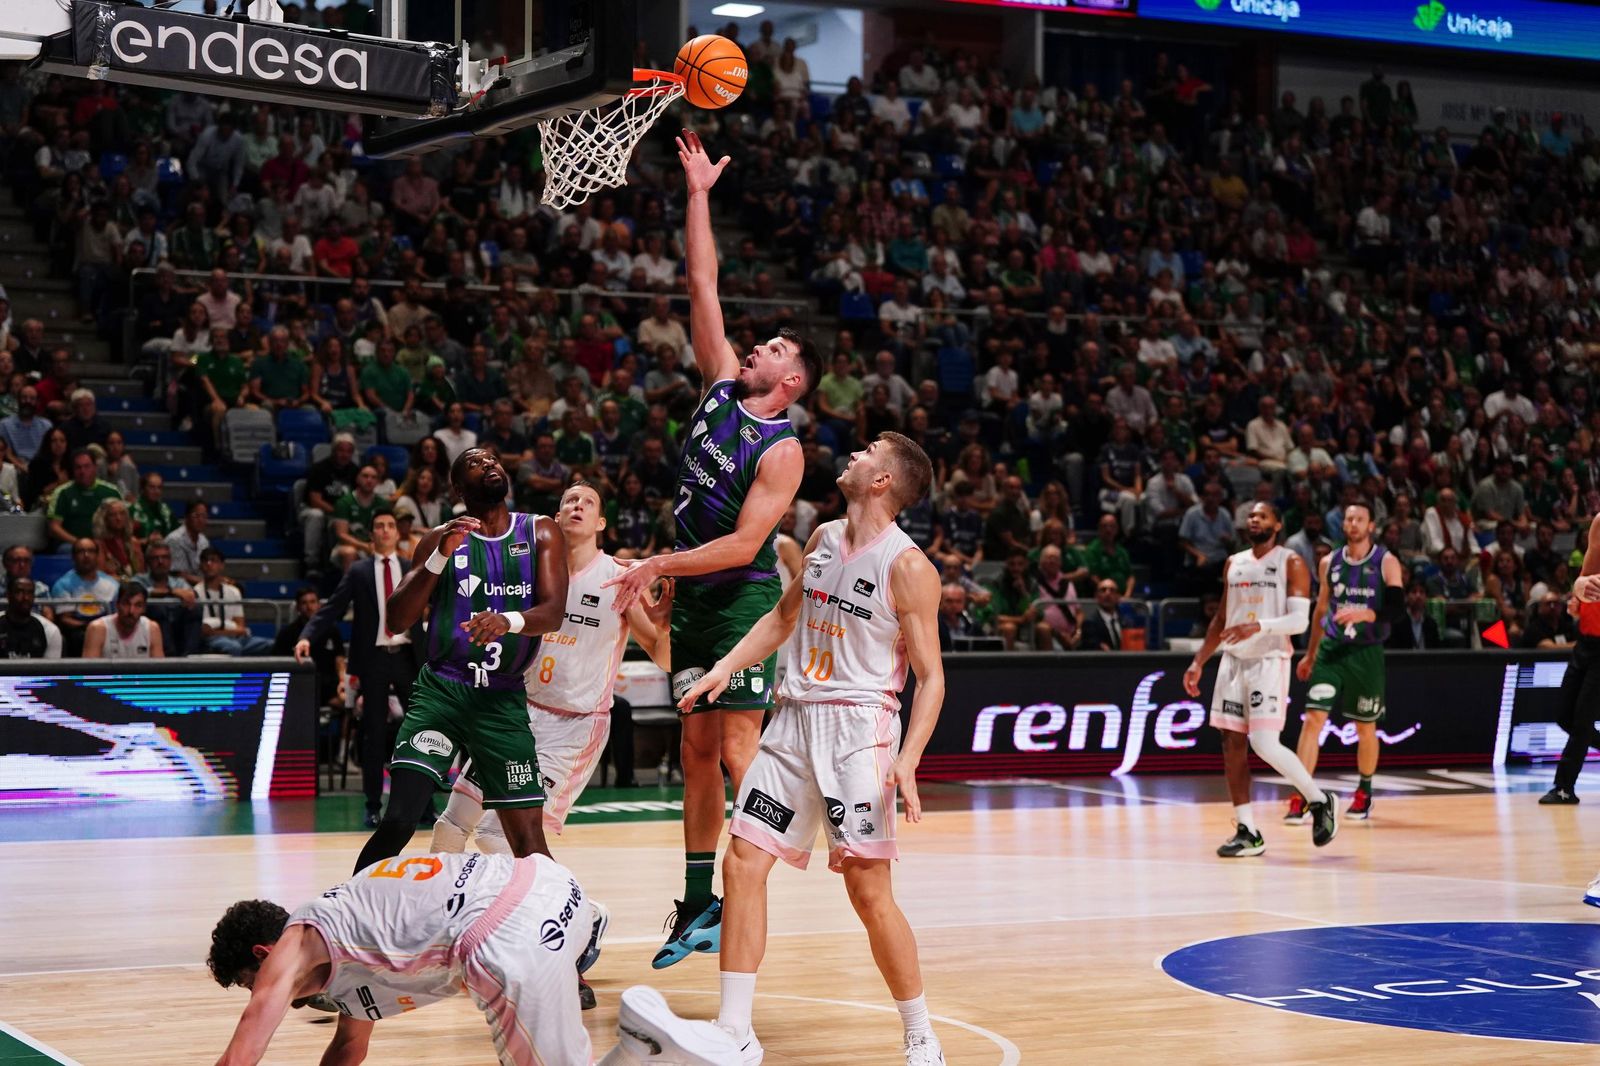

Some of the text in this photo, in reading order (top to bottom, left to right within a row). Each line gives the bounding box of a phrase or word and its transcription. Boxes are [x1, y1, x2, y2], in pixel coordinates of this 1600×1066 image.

[1447, 12, 1513, 42] Unicaja
[110, 20, 367, 91] endesa
[701, 434, 736, 474] Unicaja
[674, 485, 692, 516] 7
[484, 581, 532, 598] Unicaja
[481, 642, 503, 671] 3
[540, 656, 556, 685] 8
[803, 647, 833, 682] 10
[972, 670, 1206, 776] renfe
[507, 771, 533, 786] laga
[510, 760, 532, 774] má
[752, 797, 784, 823] PONS
[368, 857, 443, 881] 5
